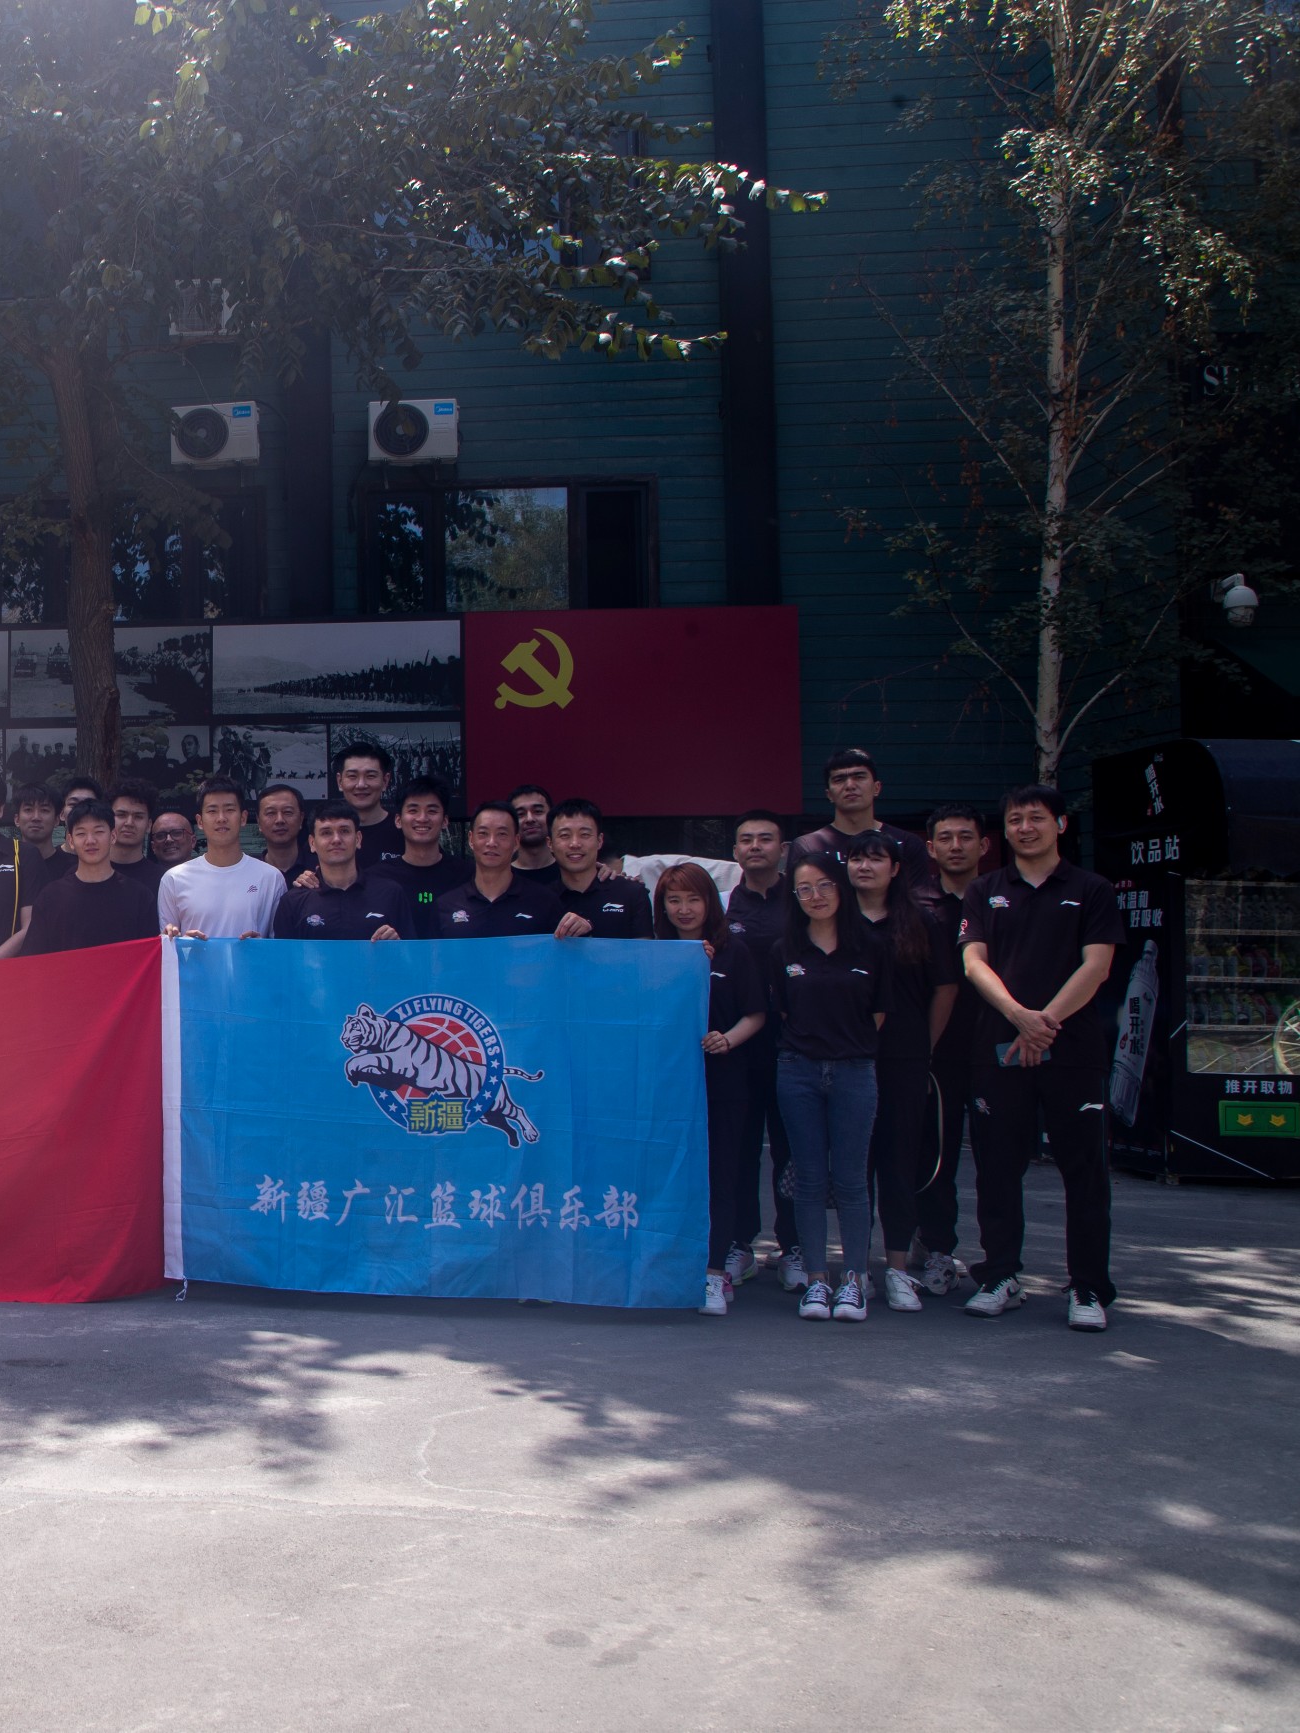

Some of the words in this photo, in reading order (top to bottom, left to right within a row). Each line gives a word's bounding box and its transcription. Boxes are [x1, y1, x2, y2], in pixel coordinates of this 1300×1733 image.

[1144, 763, 1166, 816] 喝开水
[1130, 835, 1180, 865] 饮品站
[1129, 908, 1164, 928] 好吸收
[394, 1004, 414, 1020] XJ
[413, 997, 464, 1017] FLYING
[463, 1007, 501, 1056] TIGERS
[1129, 996, 1141, 1056] 喝开水
[1225, 1079, 1293, 1095] 推开取物
[409, 1099, 465, 1131] 新疆
[251, 1174, 639, 1240] 新疆广汇篮球俱乐部
